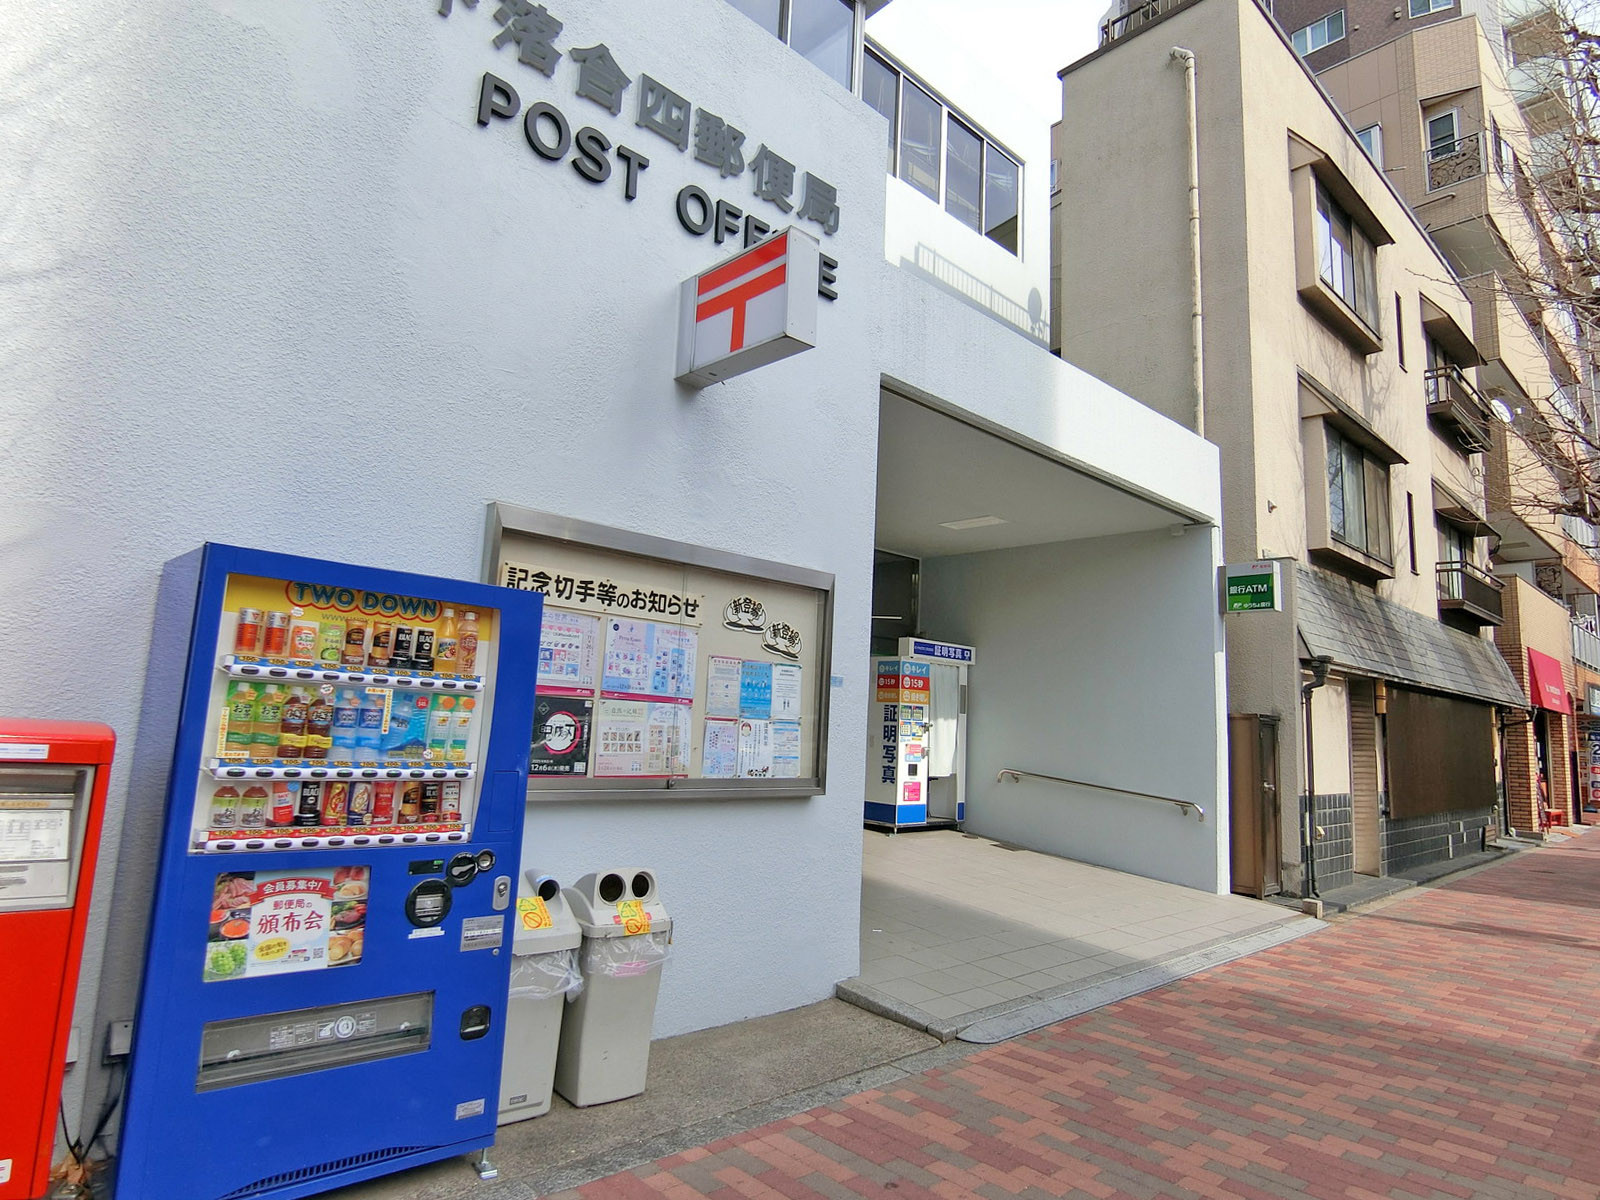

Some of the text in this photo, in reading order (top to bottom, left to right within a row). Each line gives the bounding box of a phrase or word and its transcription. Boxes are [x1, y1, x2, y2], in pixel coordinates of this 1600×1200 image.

[437, 0, 841, 236] 落合四郵便局
[476, 72, 839, 302] POST OFFE
[293, 582, 438, 618] TWO DOWN
[506, 566, 700, 618] 記念切手等のお知らせ
[1229, 584, 1268, 594] 銀行ATM
[731, 597, 763, 618] 新登場
[770, 621, 800, 646] 新登場
[934, 644, 963, 660] 証明写真
[911, 665, 927, 674] キレイ
[910, 678, 924, 688] 15秒
[882, 704, 897, 784] 証明写真
[263, 879, 323, 894] 会員募集中!
[272, 898, 313, 910] 郵便局の
[256, 910, 324, 935] 頒布会
